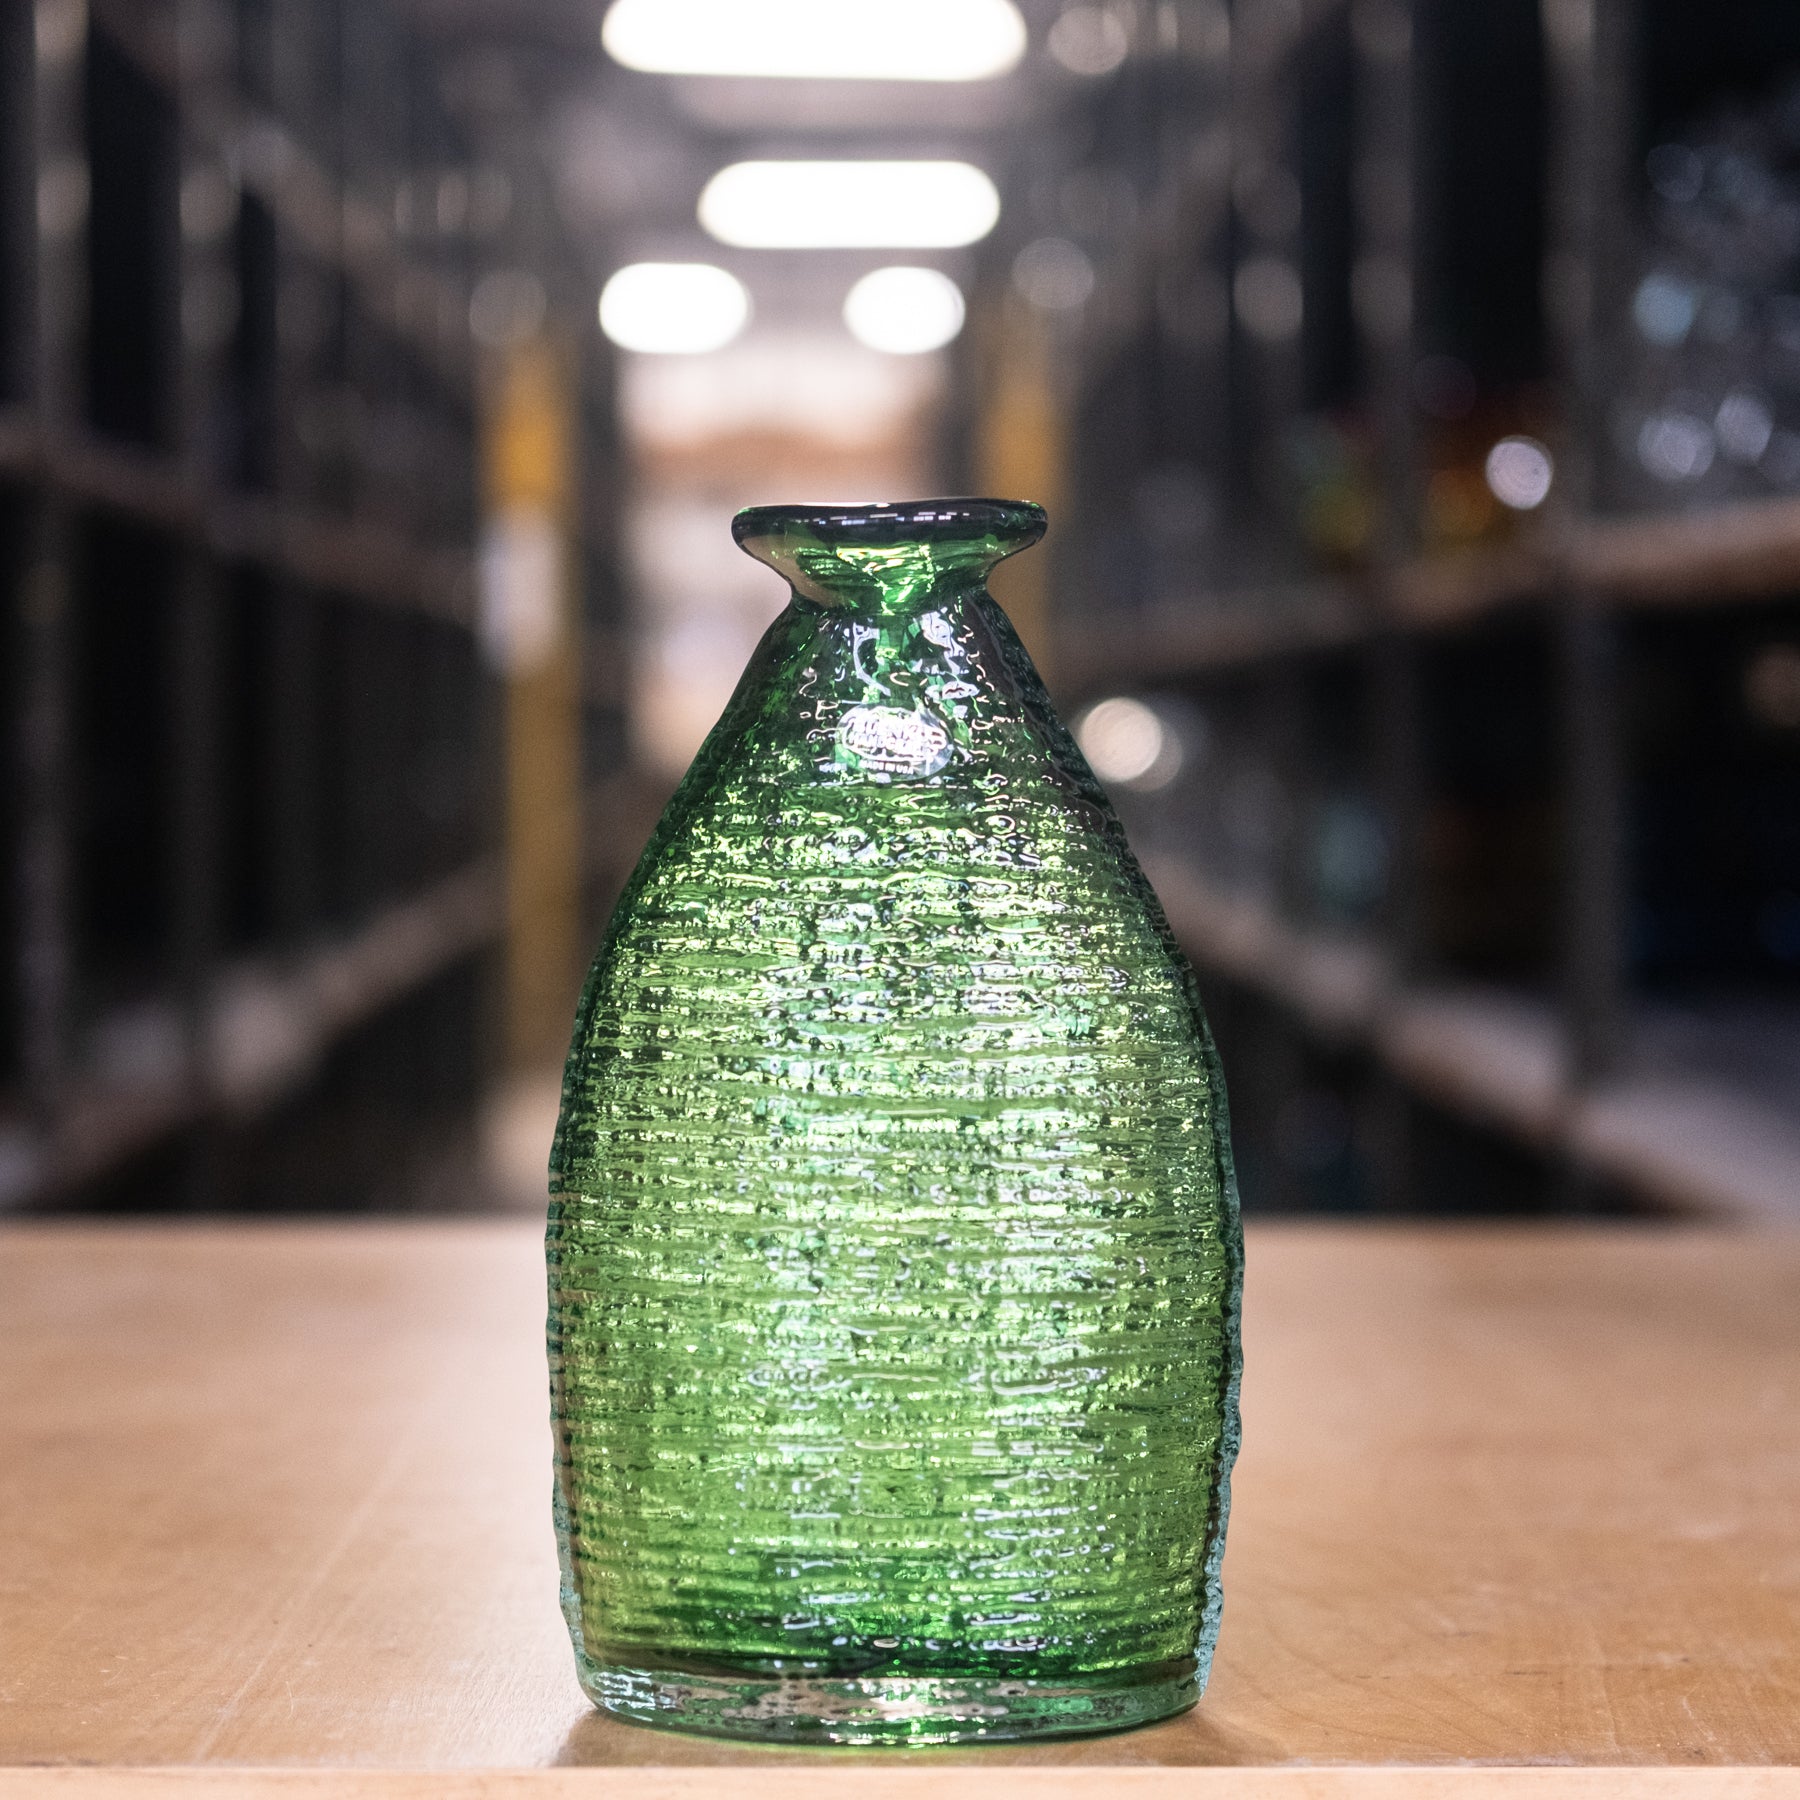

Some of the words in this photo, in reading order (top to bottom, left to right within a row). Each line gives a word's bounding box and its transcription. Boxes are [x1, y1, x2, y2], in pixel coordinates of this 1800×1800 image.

[859, 760, 884, 770] MADE
[885, 763, 895, 772] IN
[896, 765, 914, 774] USA
